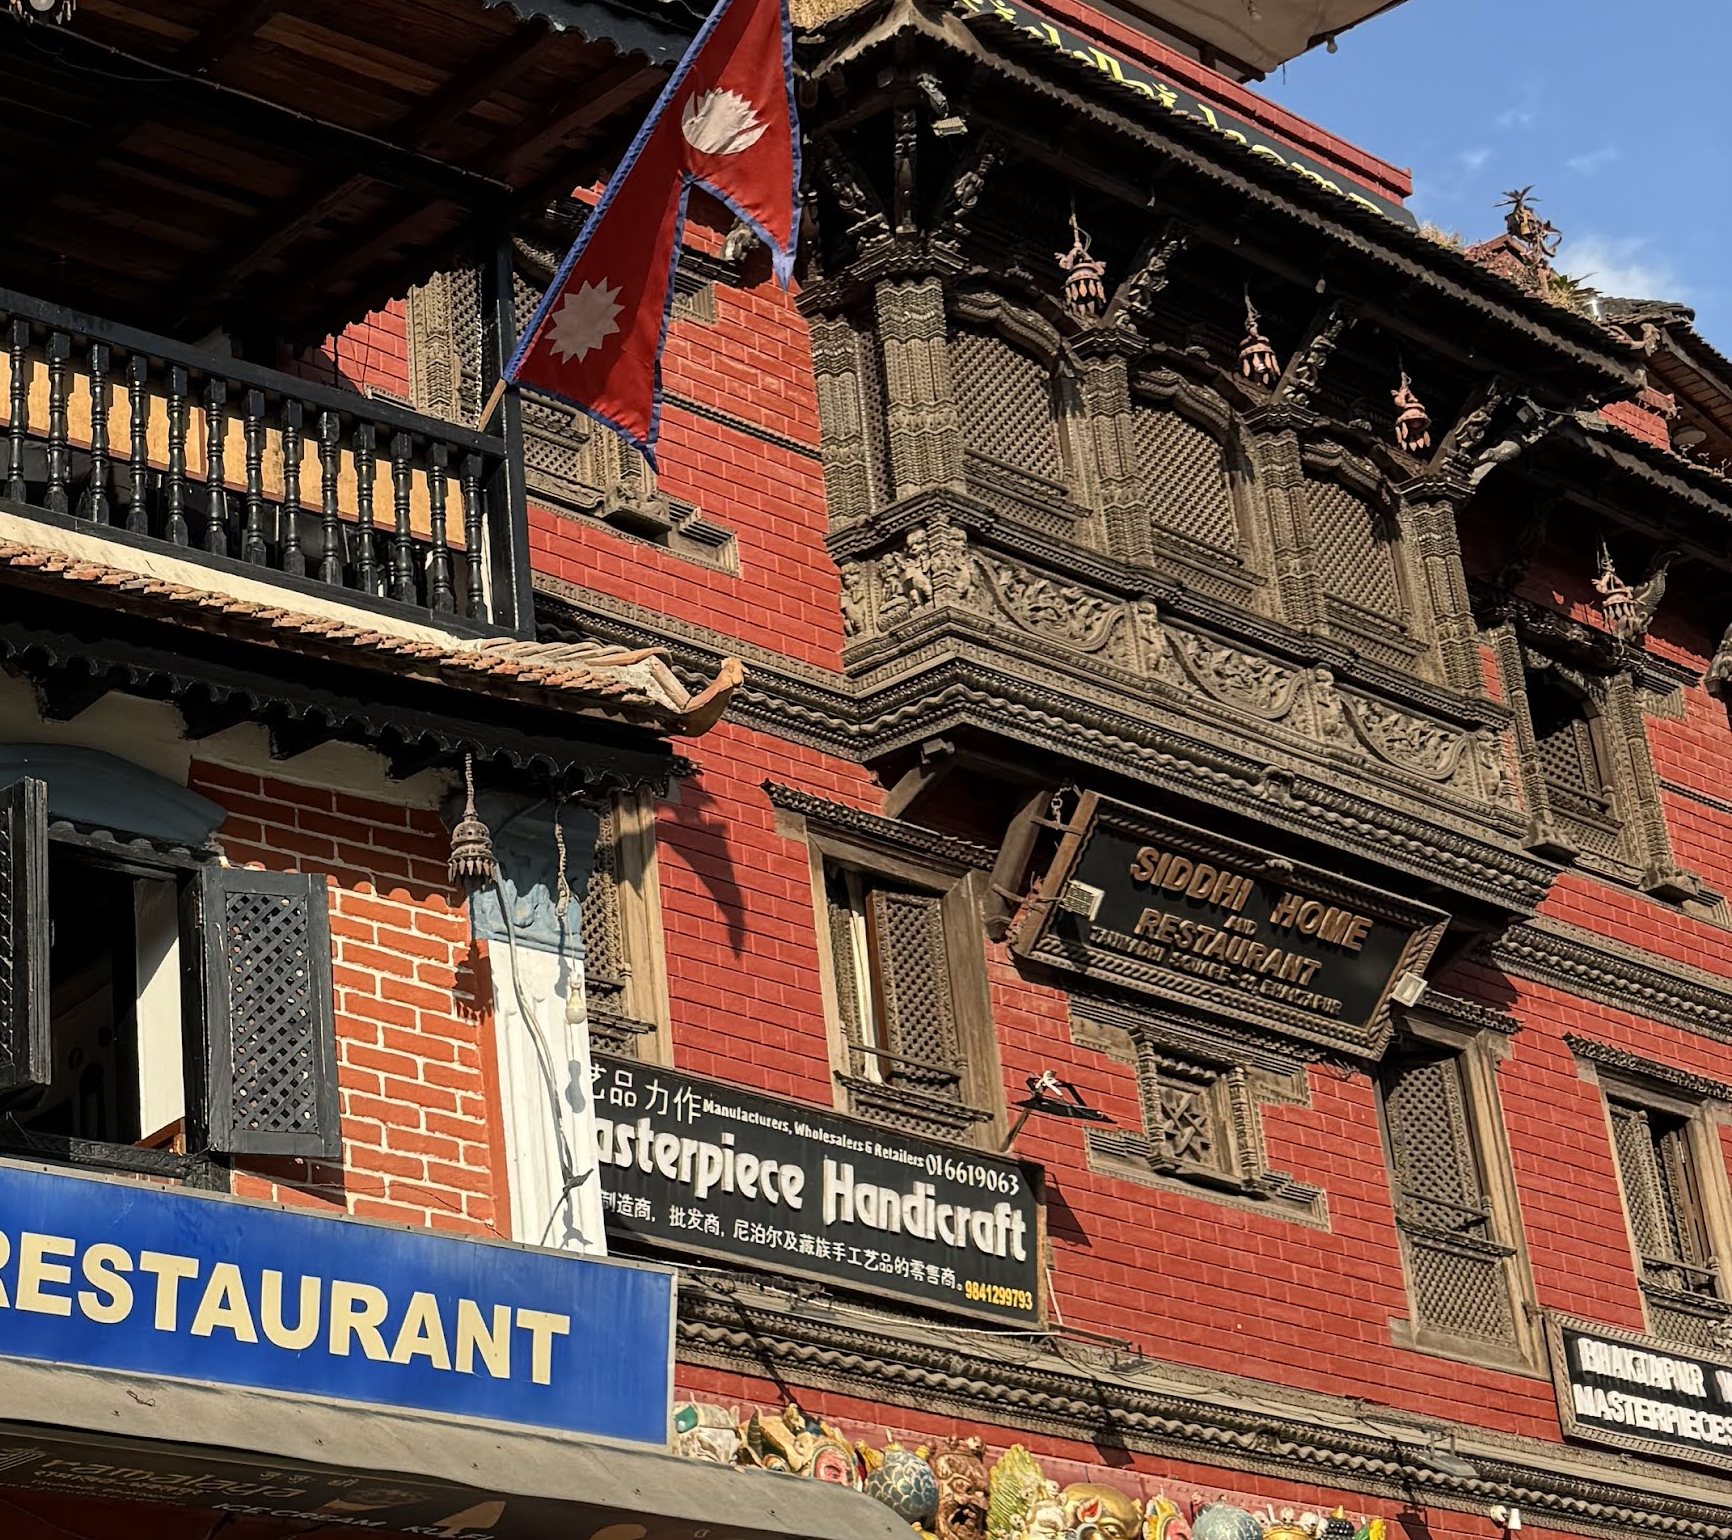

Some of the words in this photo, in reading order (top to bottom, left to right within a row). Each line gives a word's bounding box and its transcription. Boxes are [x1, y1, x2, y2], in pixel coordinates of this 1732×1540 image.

[1130, 845, 1254, 912] SIDDHI
[1269, 892, 1373, 950] HOME
[1224, 915, 1257, 935] AND
[1134, 908, 1322, 986] RESTAURANT
[703, 1099, 792, 1135] Manufacturers,
[794, 1122, 864, 1152] Wholesalers
[875, 1144, 924, 1168] Retailers
[926, 1154, 1019, 1196] 016619063
[596, 1117, 805, 1209] asterpiece
[823, 1155, 1027, 1261] Handicraft
[965, 1281, 1033, 1310] 9841299793
[1578, 1337, 1707, 1397] BHAKTAPUR
[42, 1459, 307, 1498] ramalaya
[269, 1508, 388, 1527] CREAM
